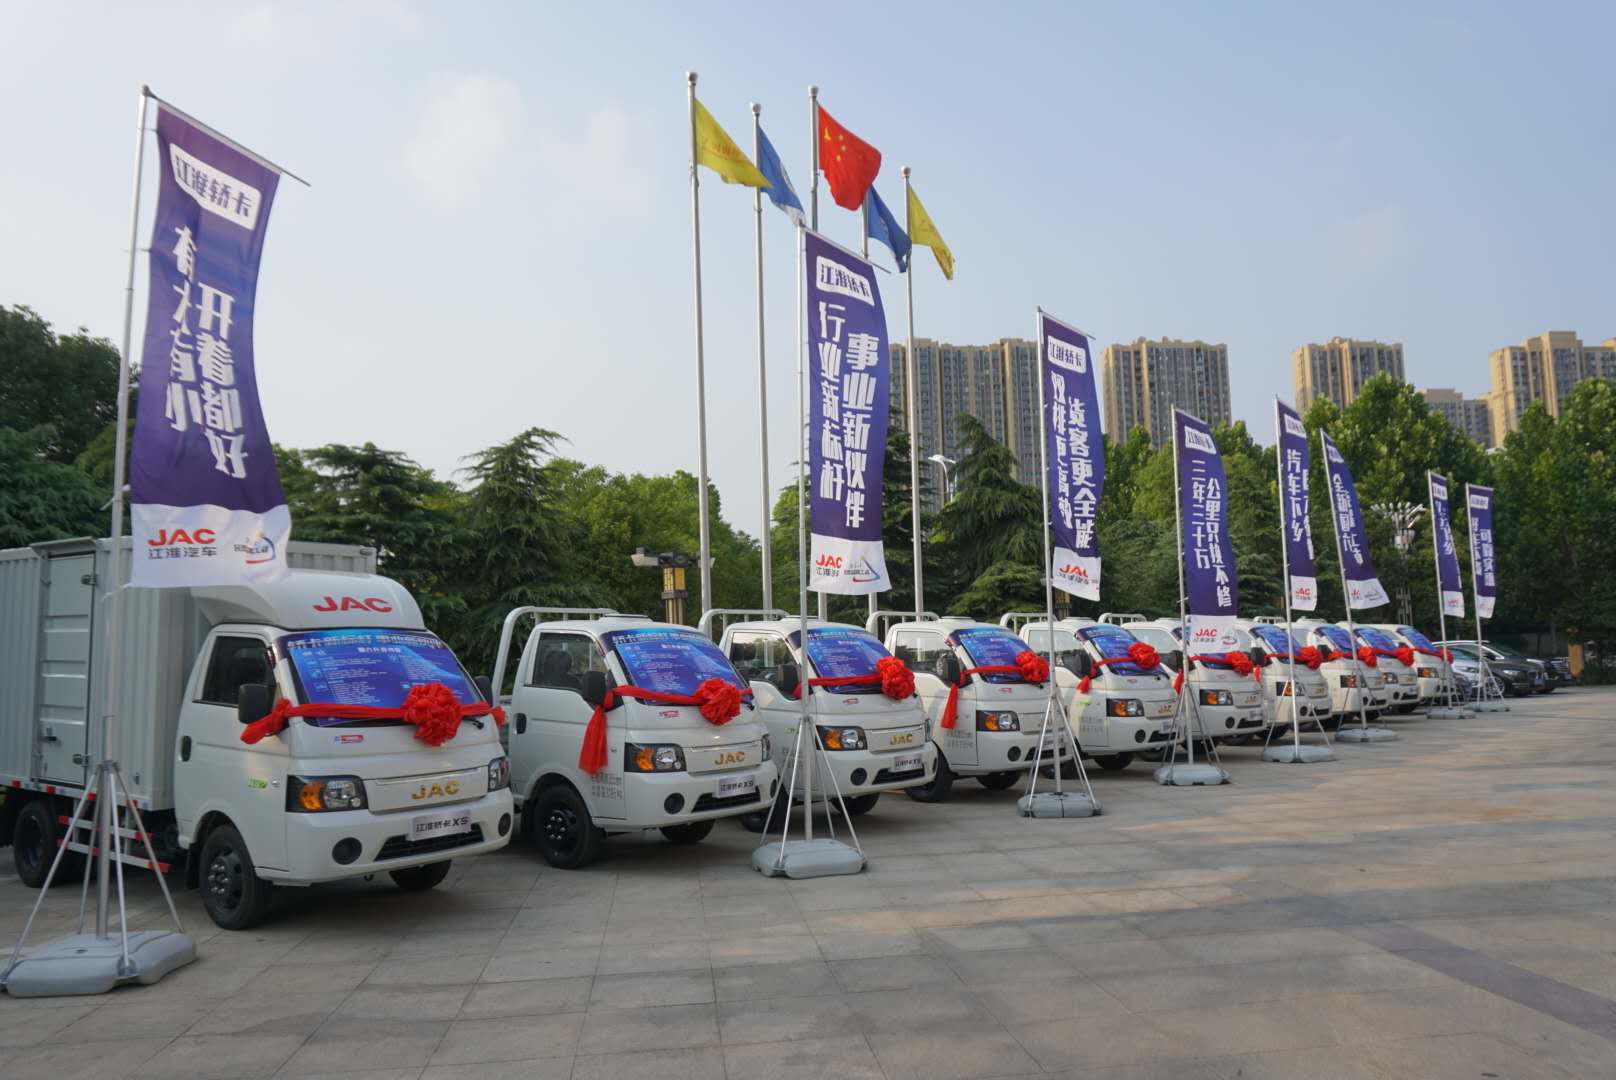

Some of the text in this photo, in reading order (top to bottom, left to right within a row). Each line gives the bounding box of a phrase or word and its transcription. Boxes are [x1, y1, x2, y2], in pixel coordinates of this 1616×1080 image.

[175, 153, 255, 217] 江淮轿卡
[820, 263, 870, 297] 江淮轿卡
[165, 225, 200, 432] 有大有小
[197, 281, 249, 479] 开着都好
[817, 301, 847, 501] 行业新标杆
[842, 332, 880, 529] 事业新伙伴
[1191, 459, 1211, 569] 三年三十万
[147, 528, 216, 547] JAC
[1205, 477, 1232, 608] 公里只换不修
[148, 546, 217, 560] 江淮汽车
[815, 553, 843, 569] JAC
[312, 596, 393, 613] JAC
[1195, 628, 1218, 637] JAC
[889, 733, 913, 746] JAC
[714, 751, 745, 766] JAC
[411, 780, 460, 800] JAC
